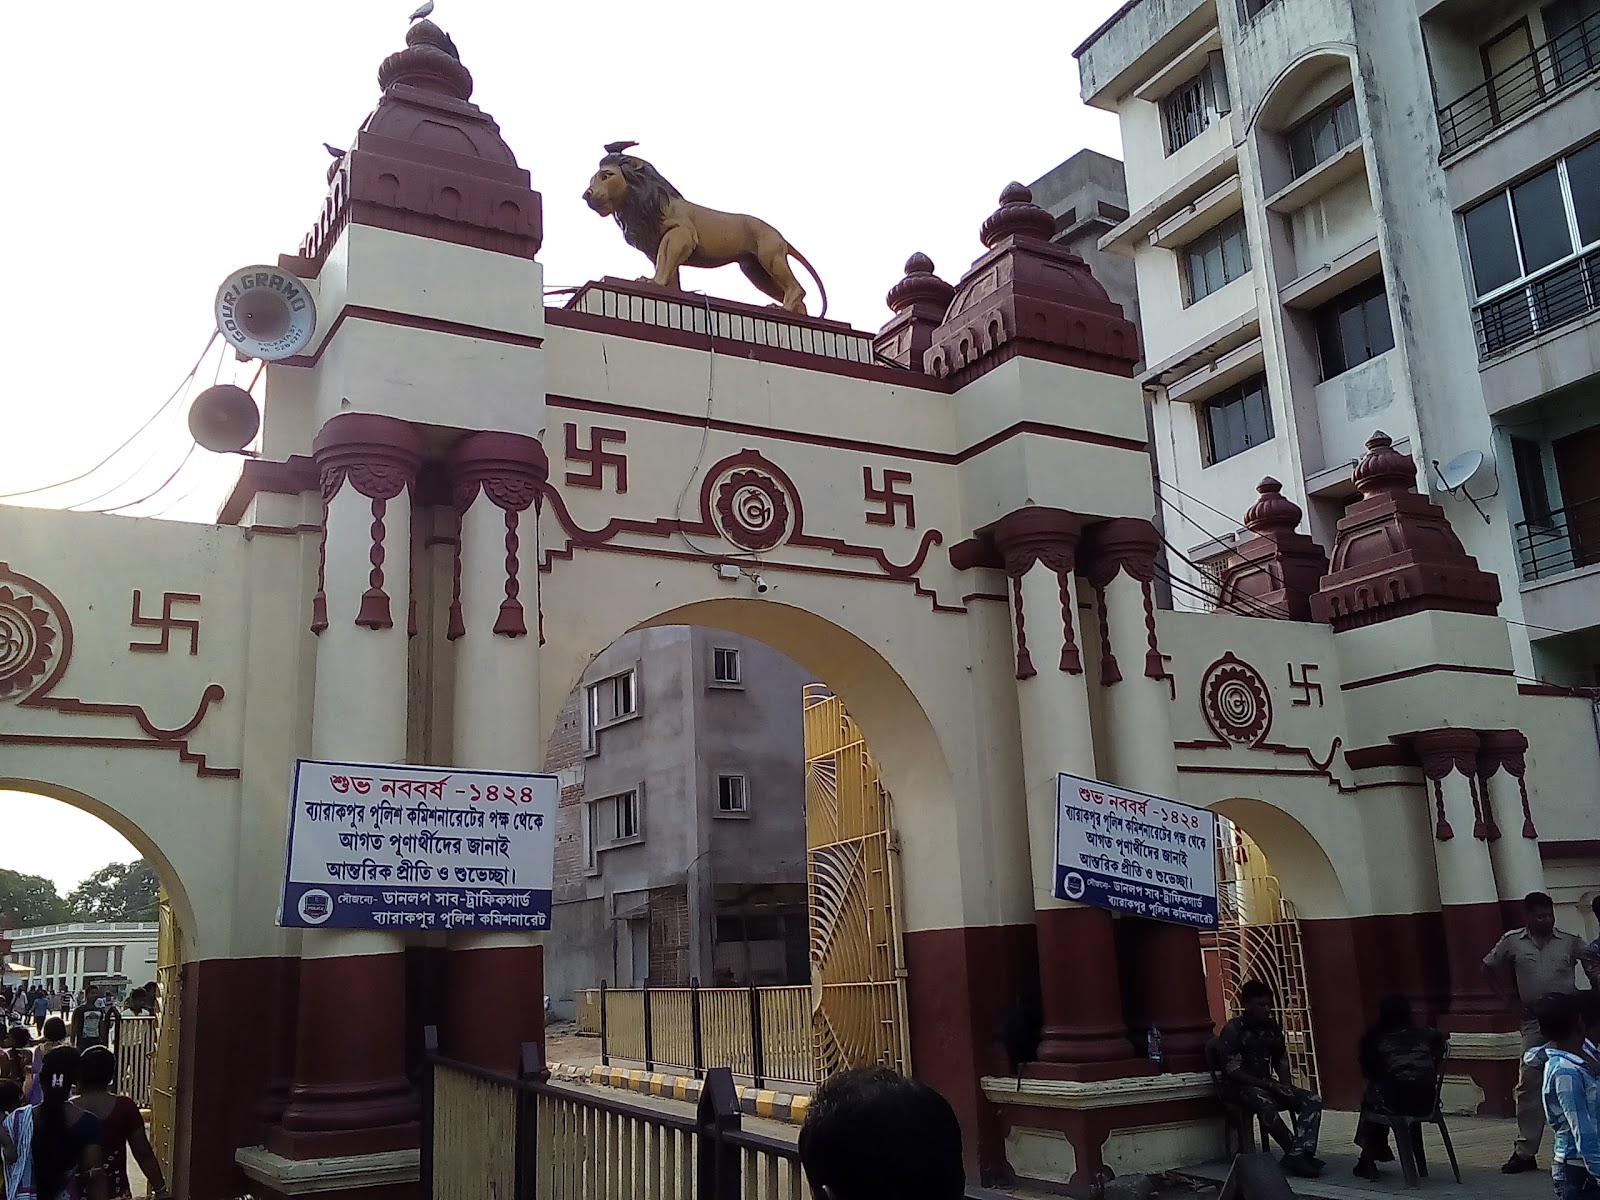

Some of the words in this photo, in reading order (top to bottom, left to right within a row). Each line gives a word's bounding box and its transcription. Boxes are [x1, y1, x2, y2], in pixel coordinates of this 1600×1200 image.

[330, 774, 374, 795] শুভ
[379, 774, 453, 801] নববর্ষ
[1078, 786, 1105, 805] শুভ
[1108, 794, 1151, 817] নববর্ষ
[369, 799, 404, 831] পুলিশ
[405, 801, 486, 828] কমিশনারেটের
[488, 809, 511, 830] পক্ষ
[513, 810, 545, 832] থেকে
[338, 831, 386, 851] আগত
[466, 833, 511, 859] জানাই
[1124, 815, 1172, 843] কমিশনারেটের
[1173, 830, 1187, 846] পক্ষ
[1188, 834, 1207, 850] থেকে
[1085, 831, 1113, 849] আগত
[1161, 848, 1189, 870] জানাই
[327, 858, 393, 881] আন্তরিক
[396, 859, 434, 882] প্রীতি
[436, 866, 449, 881] ও
[1079, 852, 1120, 873] আন্তরিক
[1121, 858, 1144, 878] প্রীতি
[1144, 868, 1153, 880] ও
[381, 890, 431, 906] ডানলপ
[1113, 881, 1143, 897] ডানলপ
[372, 911, 436, 930] ব্যারাকপুর
[440, 909, 475, 929] পুলিশ
[478, 910, 547, 927] কমিশনারেট
[1148, 901, 1171, 918] পুলিশ
[1171, 906, 1214, 925] কমিশনারেট
